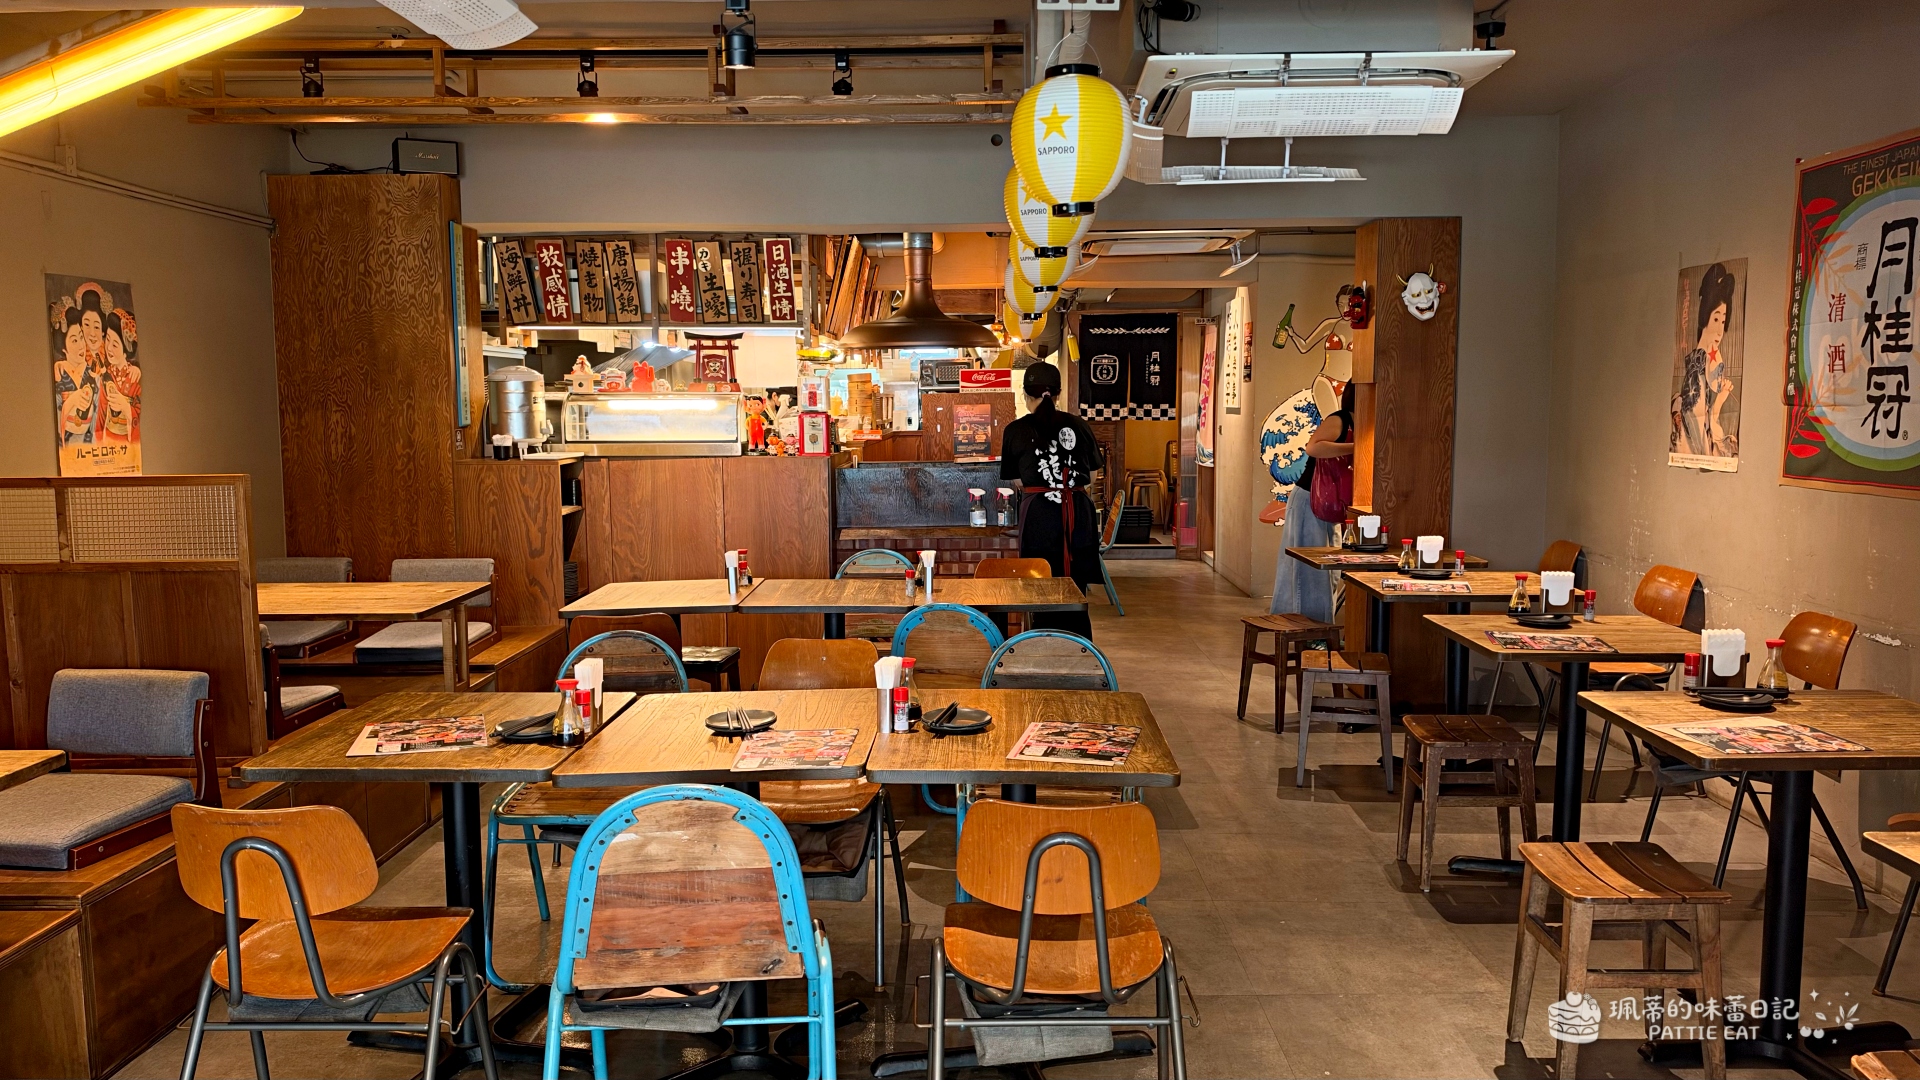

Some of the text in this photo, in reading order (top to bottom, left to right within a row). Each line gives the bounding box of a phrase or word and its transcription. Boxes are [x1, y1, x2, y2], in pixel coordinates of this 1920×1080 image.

[1037, 145, 1075, 155] SAPPORO
[1843, 162, 1859, 176] THE
[1860, 153, 1890, 171] FINEST
[1020, 208, 1048, 216] SAPPORO
[500, 245, 532, 318] 海鮮丼
[540, 245, 569, 319] 放感情
[771, 244, 793, 320] 日酒生情
[1861, 216, 1919, 439] 月桂冠
